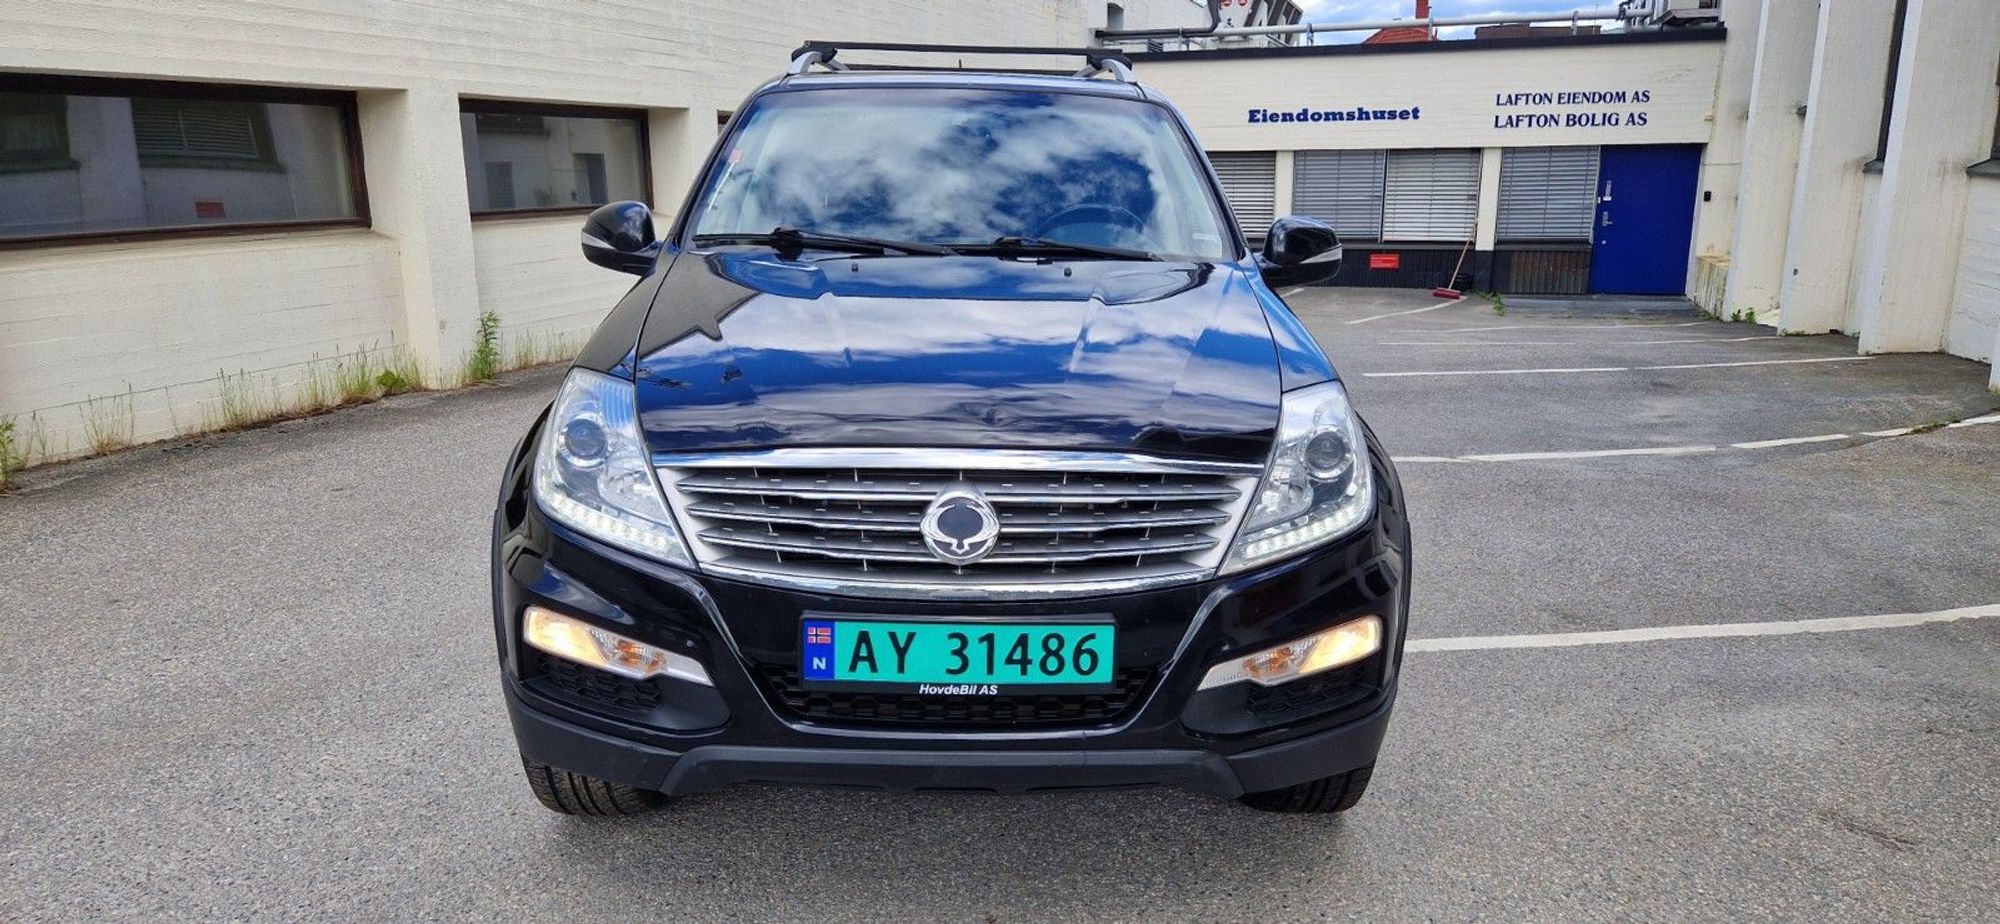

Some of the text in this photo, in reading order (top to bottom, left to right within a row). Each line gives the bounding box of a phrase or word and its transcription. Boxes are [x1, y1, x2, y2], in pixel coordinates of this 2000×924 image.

[1496, 89, 1651, 107] LAFTON EIENDOM AS
[1247, 106, 1420, 124] Eiendomshuset
[1494, 111, 1648, 129] LAFTON BOLIG AS
[848, 630, 1099, 677] AY 31486
[812, 656, 827, 670] N
[919, 683, 999, 696] HovdeBil AS
